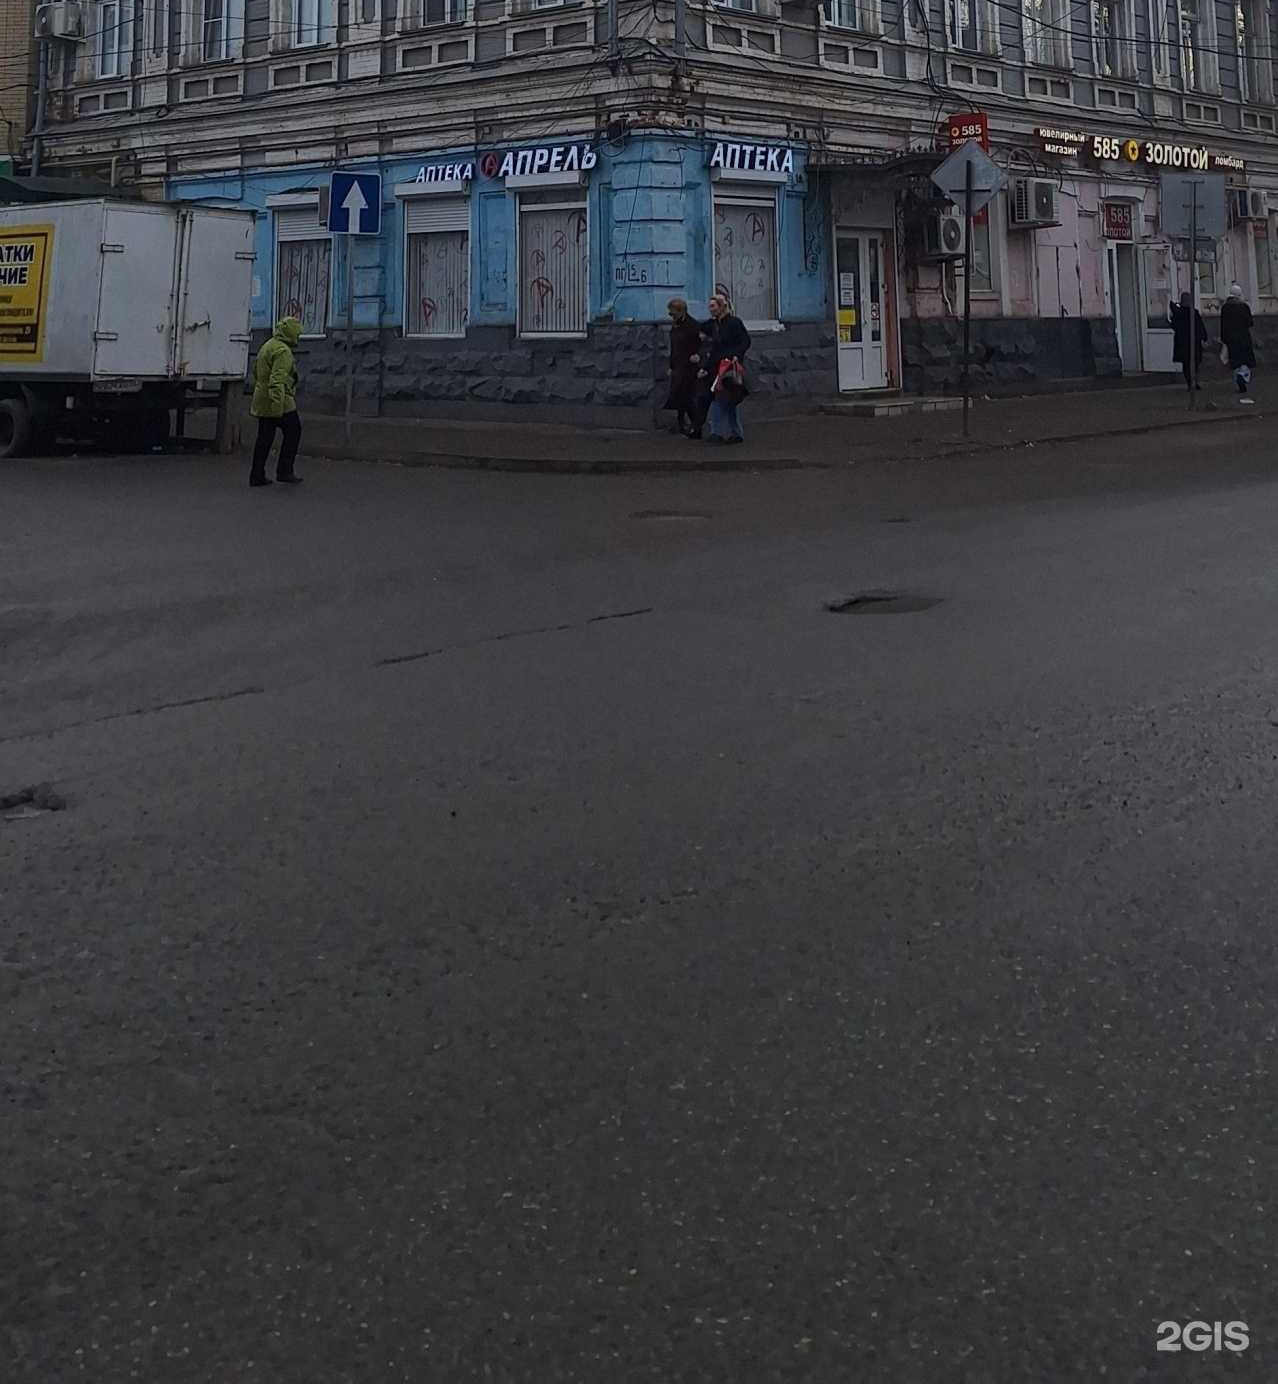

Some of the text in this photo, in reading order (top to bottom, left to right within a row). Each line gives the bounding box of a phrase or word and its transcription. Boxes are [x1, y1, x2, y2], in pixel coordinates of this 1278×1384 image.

[961, 124, 982, 136] 585
[710, 142, 793, 173] АПТЕКА
[1045, 143, 1079, 156] магазин
[1093, 136, 1209, 170] 585 ЗОЛОТОЙ
[498, 145, 597, 177] АПРЕЛЬ
[1214, 155, 1244, 170] ломбард
[416, 163, 473, 184] АПТЕКА
[1110, 207, 1130, 224] 585
